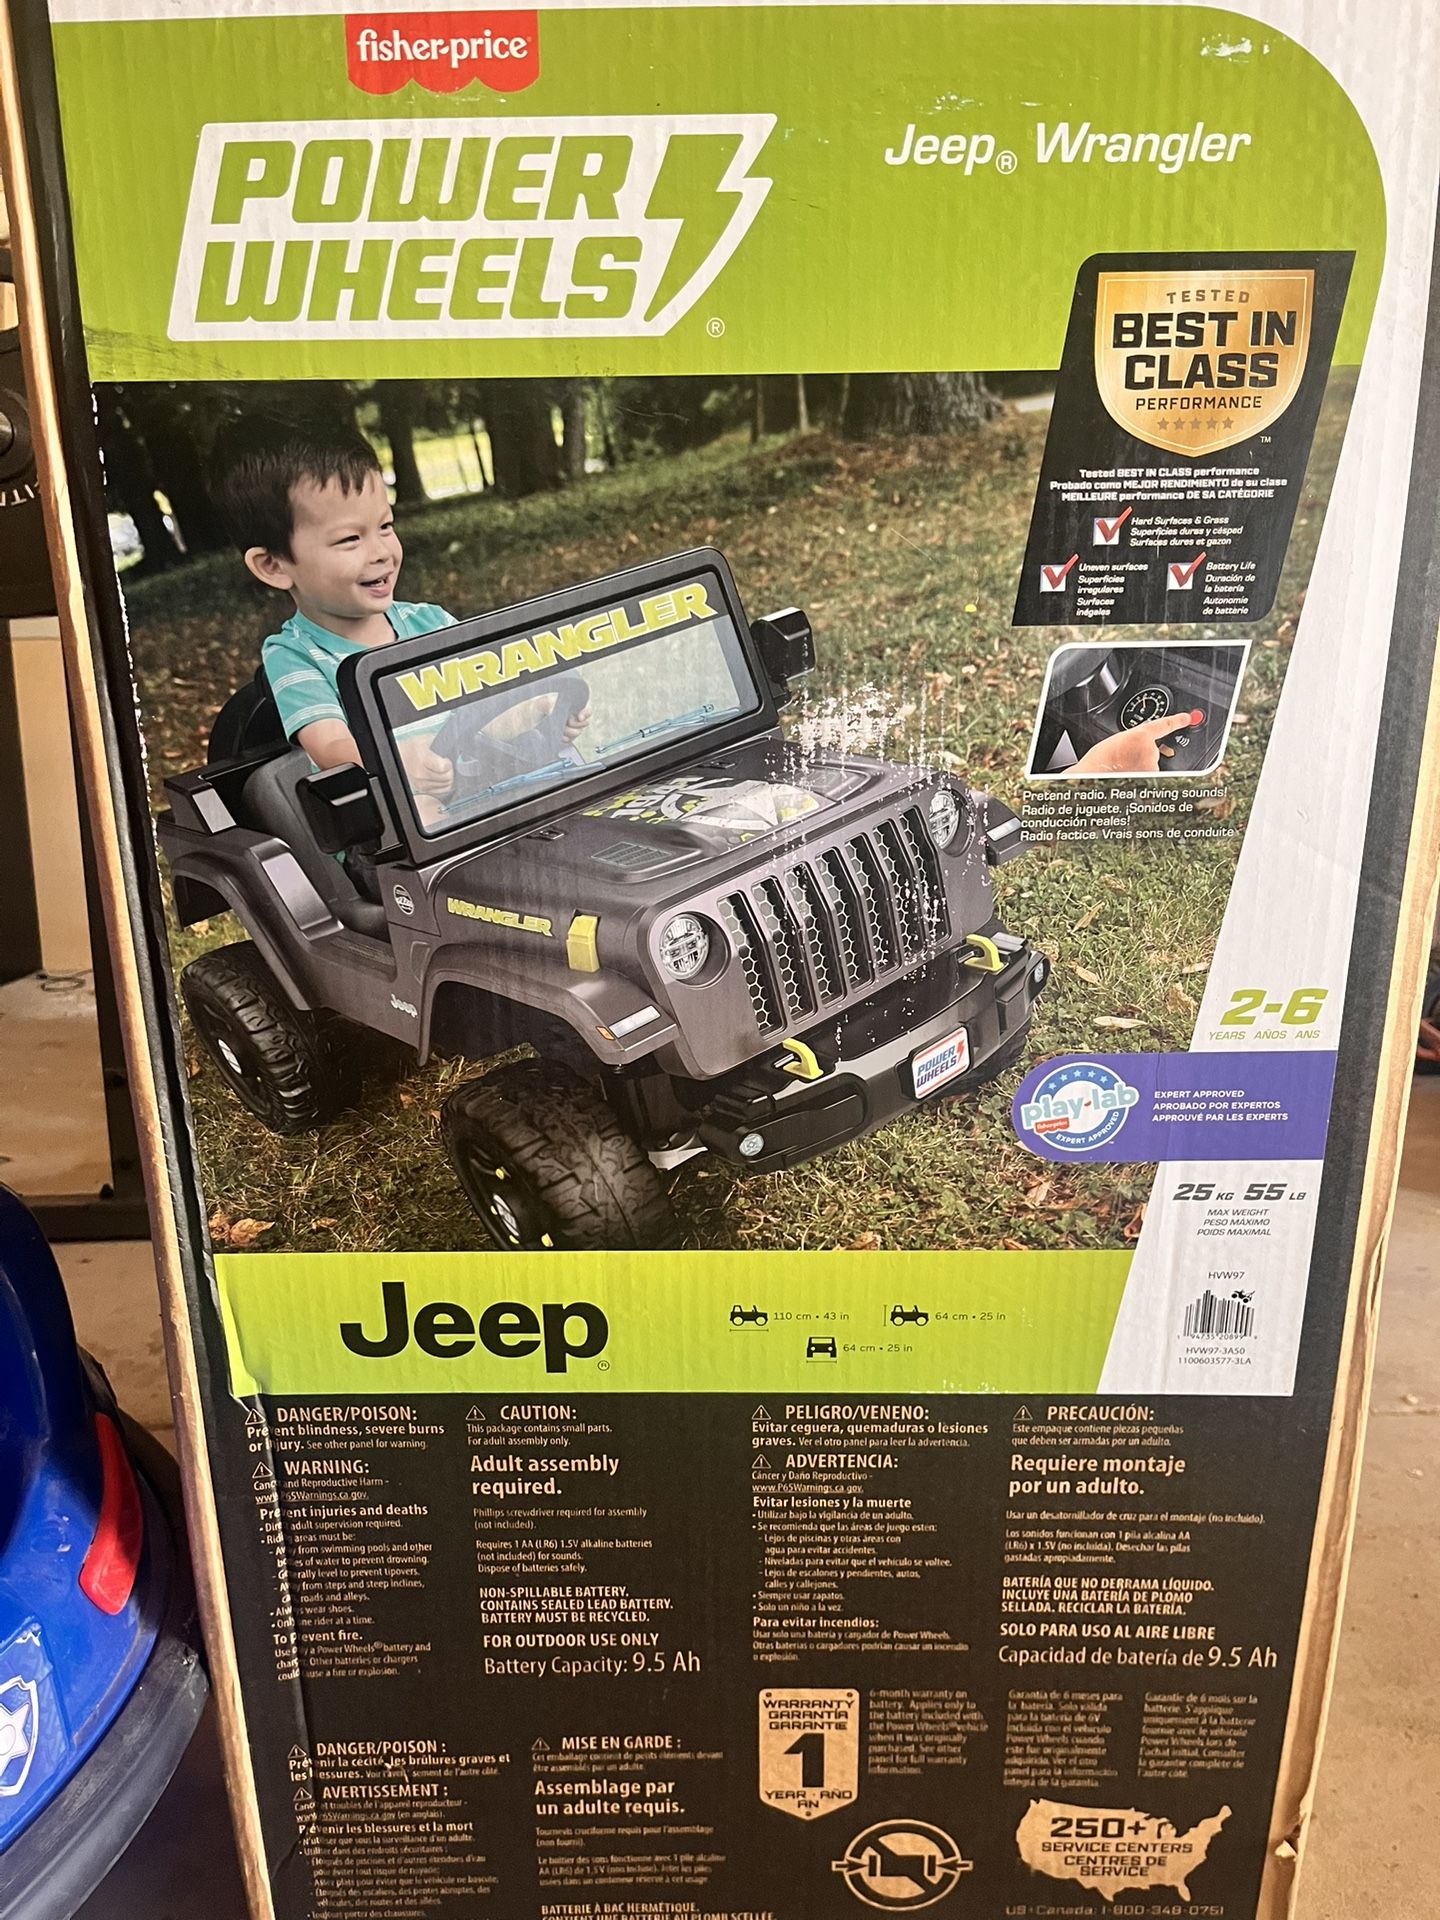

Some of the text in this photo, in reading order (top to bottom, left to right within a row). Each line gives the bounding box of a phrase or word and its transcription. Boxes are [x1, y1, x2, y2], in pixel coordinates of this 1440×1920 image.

[356, 29, 528, 69] fisher-price
[1035, 122, 1252, 174] Wrangler
[211, 134, 632, 225] POWER
[195, 236, 642, 324] WHEELS
[1167, 290, 1250, 304] TESTED
[1113, 311, 1296, 348] BEST IN
[1125, 353, 1279, 390] CLASS
[1136, 396, 1262, 410] PERFORMANCE
[1080, 466, 1259, 478] Tested BEST IN CLASS performance
[1050, 482, 1091, 490] Probado
[1124, 480, 1158, 488] MEJOR
[1160, 480, 1229, 488] RENDIMIENTO
[1231, 478, 1244, 486] de
[1260, 478, 1287, 486] clase
[1062, 488, 1274, 502] MEILLEURE performance DE SA CATÉGORIE
[1154, 517, 1192, 526] Surfaces
[1203, 516, 1229, 524] Grass
[1130, 528, 1178, 536] Superficies
[1206, 528, 1211, 536] y
[1213, 526, 1242, 536] césped
[1079, 563, 1148, 571] Uneven surfaces
[1206, 562, 1256, 571] Battery Life
[395, 582, 718, 711] WRANGLER
[1023, 787, 1228, 801] Pretend radio. Real driving sounds!
[1022, 802, 1193, 816] Radio de juguete. ¡Sonidos de
[1021, 816, 1130, 828] conducción reales!
[1020, 827, 1234, 841] Radio factice. Vrais sons de conduite
[447, 897, 552, 936] WRANGLER
[1220, 988, 1328, 1026] 2-6
[1209, 1028, 1320, 1041] YEARS AÑOS ANS
[918, 1045, 955, 1076] POWER
[917, 1056, 957, 1088] WHEELS
[1154, 1089, 1244, 1099] EXPERT APPROVED
[1153, 1101, 1281, 1111] APROBADO POR EXPERTOS
[1152, 1110, 1288, 1122] APPROUVÉ PAR LES EXPERTS
[1056, 1134, 1085, 1144] EXPERT
[1088, 1111, 1119, 1142] APPROVED
[1173, 1184, 1216, 1200] 25
[1243, 1184, 1287, 1200] 55
[1289, 1192, 1306, 1200] LB
[1230, 1217, 1270, 1226] MÁXIMO
[773, 1312, 849, 1321] 110 cm 43 in
[935, 1312, 1006, 1321] 64 cm 25 in
[277, 1406, 417, 1422] DANGER/POISON:
[500, 1405, 577, 1420] CAUTION:
[785, 1405, 929, 1420] PELIGRO/VENENO:
[1048, 1404, 1154, 1420] PRECAUCIÓN:
[284, 1460, 370, 1475] WARNING:
[471, 1455, 619, 1475] Adult assembly
[786, 1455, 898, 1468] ADVERTENCIA:
[1011, 1454, 1186, 1476] Requiere montaje
[472, 1478, 562, 1499] required.
[1009, 1477, 1144, 1497] por un adulto.
[483, 1633, 659, 1647] FOR OUTDOOR USE ONLY
[484, 1651, 700, 1676] Battery Capacity: 9.5 Ah
[998, 1646, 1278, 1668] Capacidad de batería de 9.5 Ah
[763, 1700, 855, 1709] WARRANTY
[768, 1708, 848, 1719] GARANTÍA
[769, 1721, 847, 1730] GARANTIE
[562, 1736, 672, 1749] MISE EN GARDE
[784, 1733, 824, 1788] 1
[323, 1784, 439, 1799] AVERTISSEMENT
[535, 1779, 675, 1798] Assemblage par
[765, 1789, 852, 1799] YEAR AÑO
[536, 1799, 685, 1816] un adulte requis.
[798, 1800, 819, 1808] AN
[1051, 1817, 1146, 1838] 250+
[1042, 1842, 1193, 1853] SERVICE CENTERS
[1064, 1856, 1167, 1866] CENTRES DE
[1080, 1866, 1148, 1876] SERVICE
